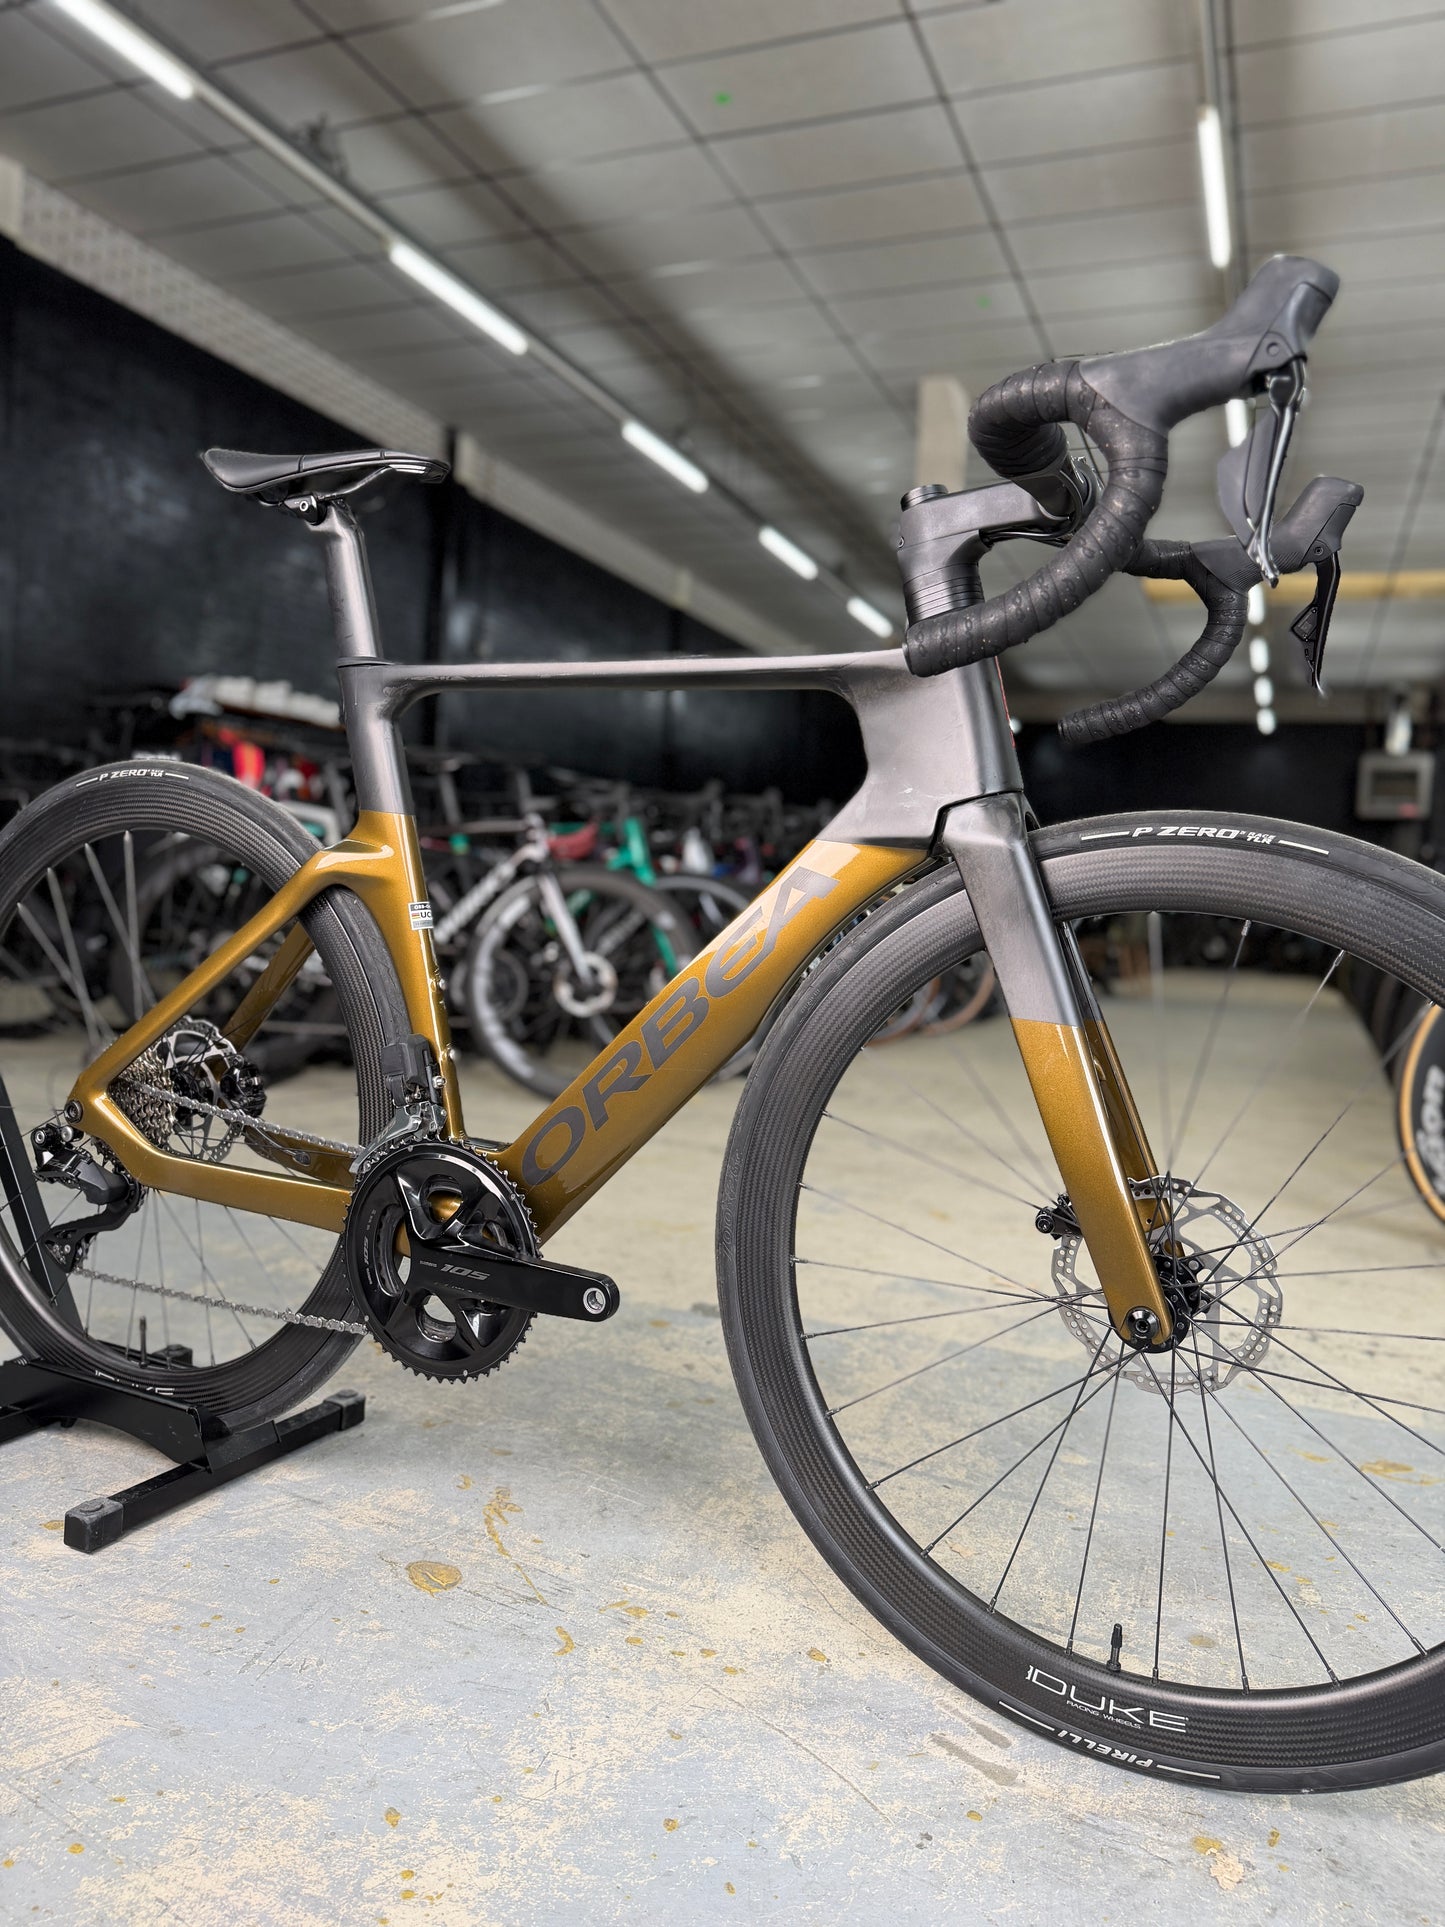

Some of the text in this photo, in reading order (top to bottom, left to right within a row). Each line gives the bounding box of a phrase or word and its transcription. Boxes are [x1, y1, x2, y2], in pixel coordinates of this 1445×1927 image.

[99, 773, 109, 781] P
[110, 768, 148, 779] ZERO
[1132, 826, 1240, 839] P ZERO
[521, 866, 841, 1187] ORBEA
[440, 1263, 491, 1281] 105
[1066, 1700, 1142, 1730] RACING WHEELS
[1057, 1729, 1154, 1768] PIRELLI
